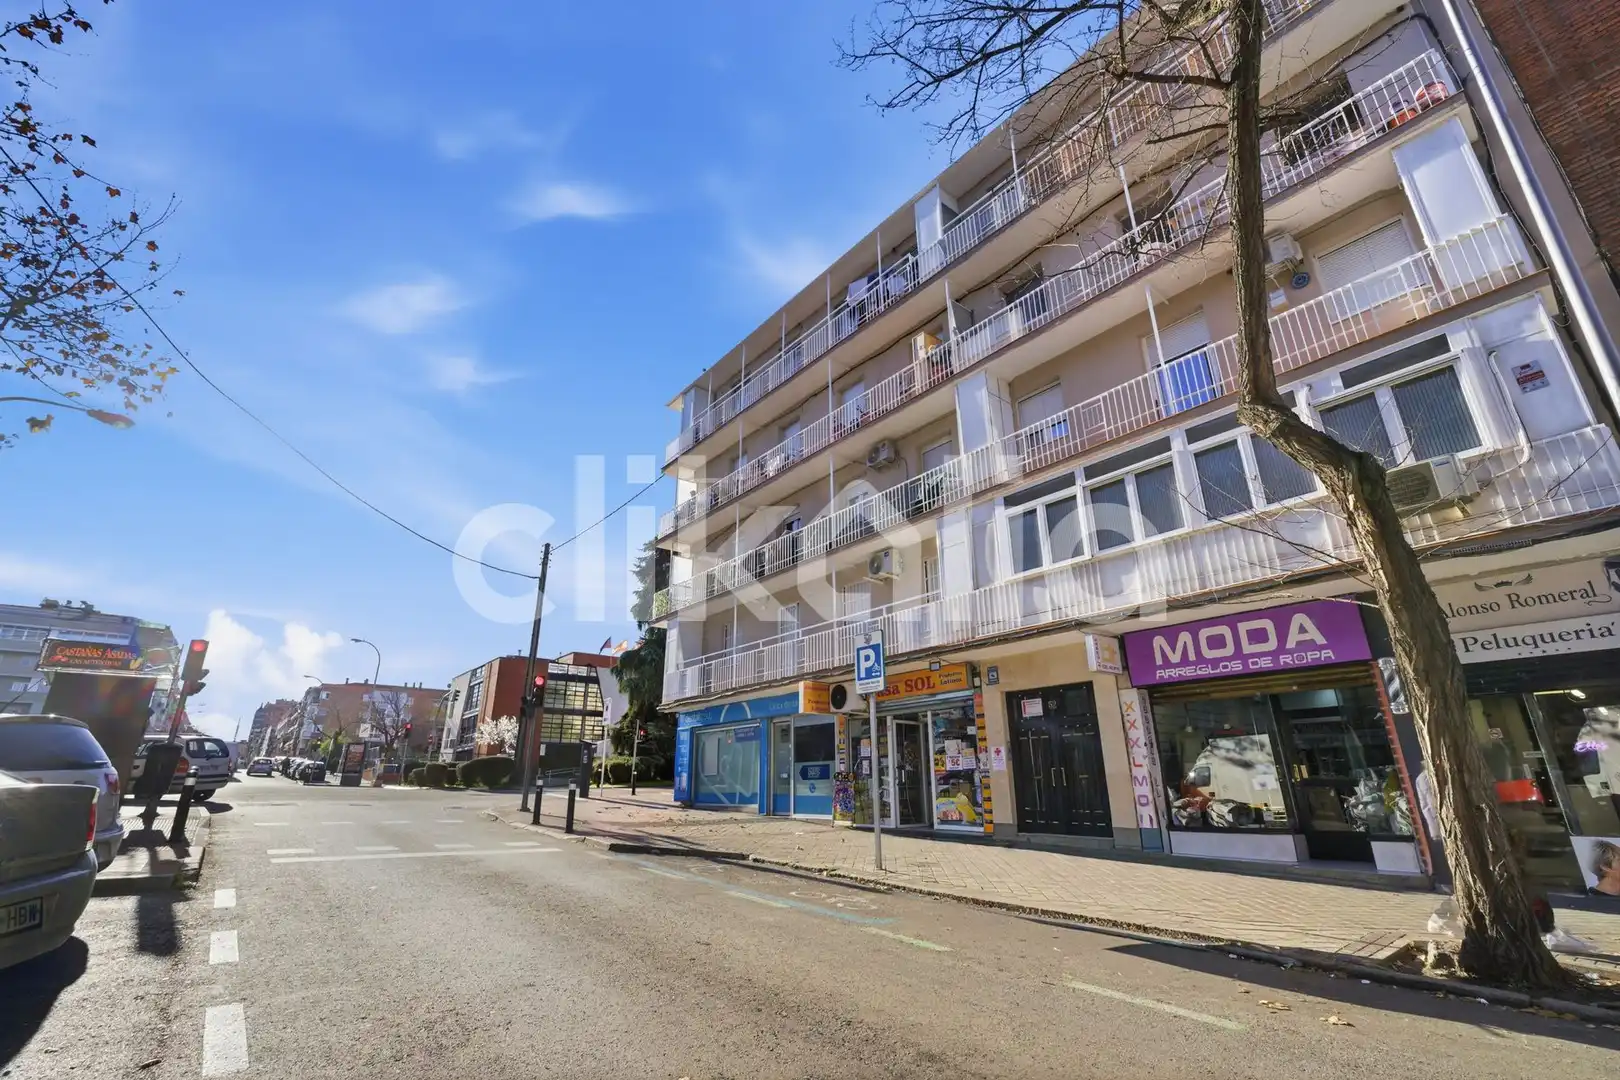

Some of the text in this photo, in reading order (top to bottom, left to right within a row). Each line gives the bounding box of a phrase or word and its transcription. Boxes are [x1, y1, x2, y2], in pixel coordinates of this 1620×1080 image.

[1505, 580, 1599, 610] Romeral
[1152, 612, 1328, 666] MODA
[859, 648, 875, 678] P
[1155, 649, 1335, 680] ARREGLOS DE ROPA
[876, 685, 901, 698] asa
[904, 675, 937, 693] SOL
